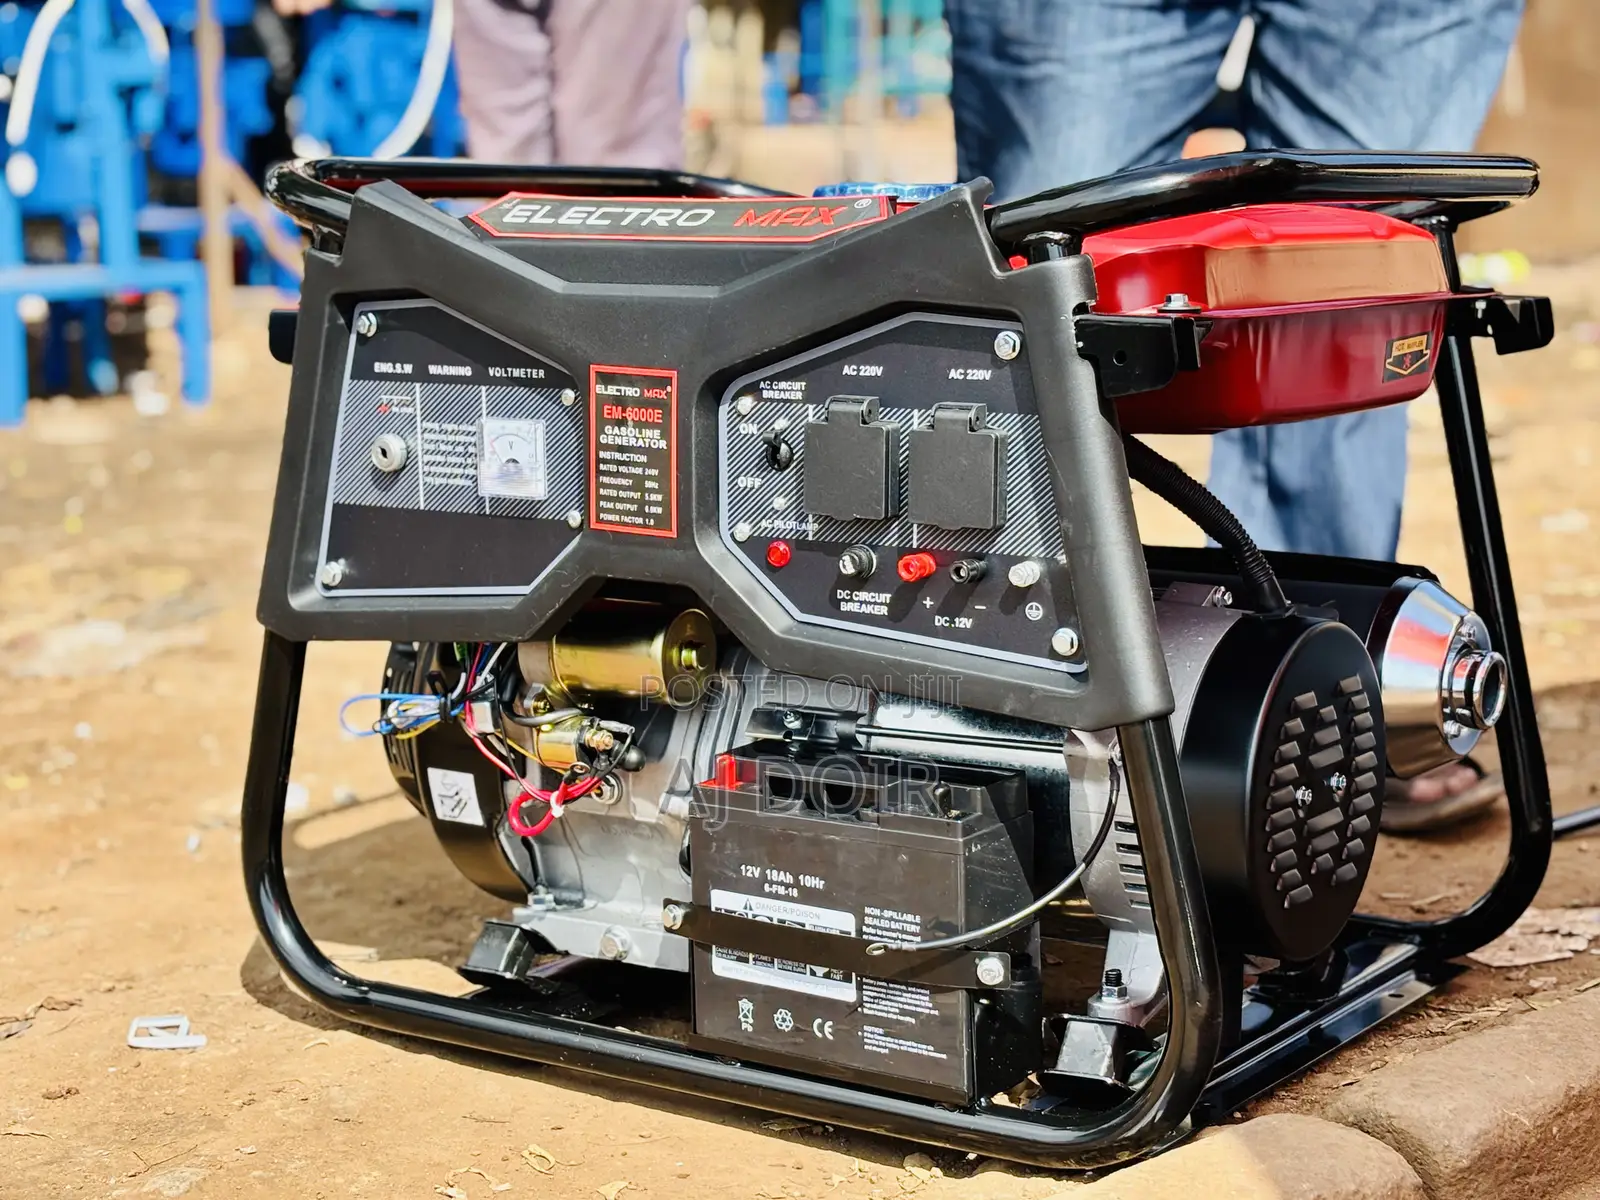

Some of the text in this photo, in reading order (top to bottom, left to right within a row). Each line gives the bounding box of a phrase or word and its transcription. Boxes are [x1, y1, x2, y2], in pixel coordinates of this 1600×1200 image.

[502, 204, 716, 227] ELECTRO
[733, 206, 848, 228] MAX
[428, 364, 472, 377] WARNING
[488, 366, 545, 379] VOLTMETER
[842, 364, 883, 377] AC 220V
[948, 368, 991, 381] AC 220V
[595, 384, 667, 399] ELECTRO MAX
[759, 381, 806, 391] AC CIRCUIT
[762, 389, 803, 400] BREAKER
[603, 404, 663, 423] EM-6000E
[605, 425, 661, 439] GASOLINE
[739, 422, 757, 435] ON
[600, 434, 667, 449] GENERATOR
[599, 450, 647, 463] INSTRUCTION
[599, 463, 617, 472] RATED
[618, 465, 643, 475] VOLTAGE
[599, 476, 633, 486] FREQUENCY
[737, 476, 762, 489] OFF
[599, 488, 617, 497] RATED
[618, 489, 641, 499] OUTPUT
[599, 500, 614, 510] PEAK
[615, 502, 638, 512] OUTPUT
[599, 513, 620, 522] POWER
[621, 515, 643, 525] FACTOR
[761, 518, 773, 529] AC
[836, 589, 891, 604] DC CIRCUIT
[840, 602, 888, 616] BREAKER
[934, 615, 949, 627] DC
[740, 864, 826, 890] 12V 18Ah 10Hr
[764, 883, 798, 898] 6-FM-18
[755, 901, 820, 920] DANGER/POISON
[864, 906, 880, 916] NON
[864, 916, 920, 933] SEALED BATTERY
[830, 973, 843, 981] FAST
[741, 1022, 753, 1032] Pb
[812, 1017, 834, 1040] CE
